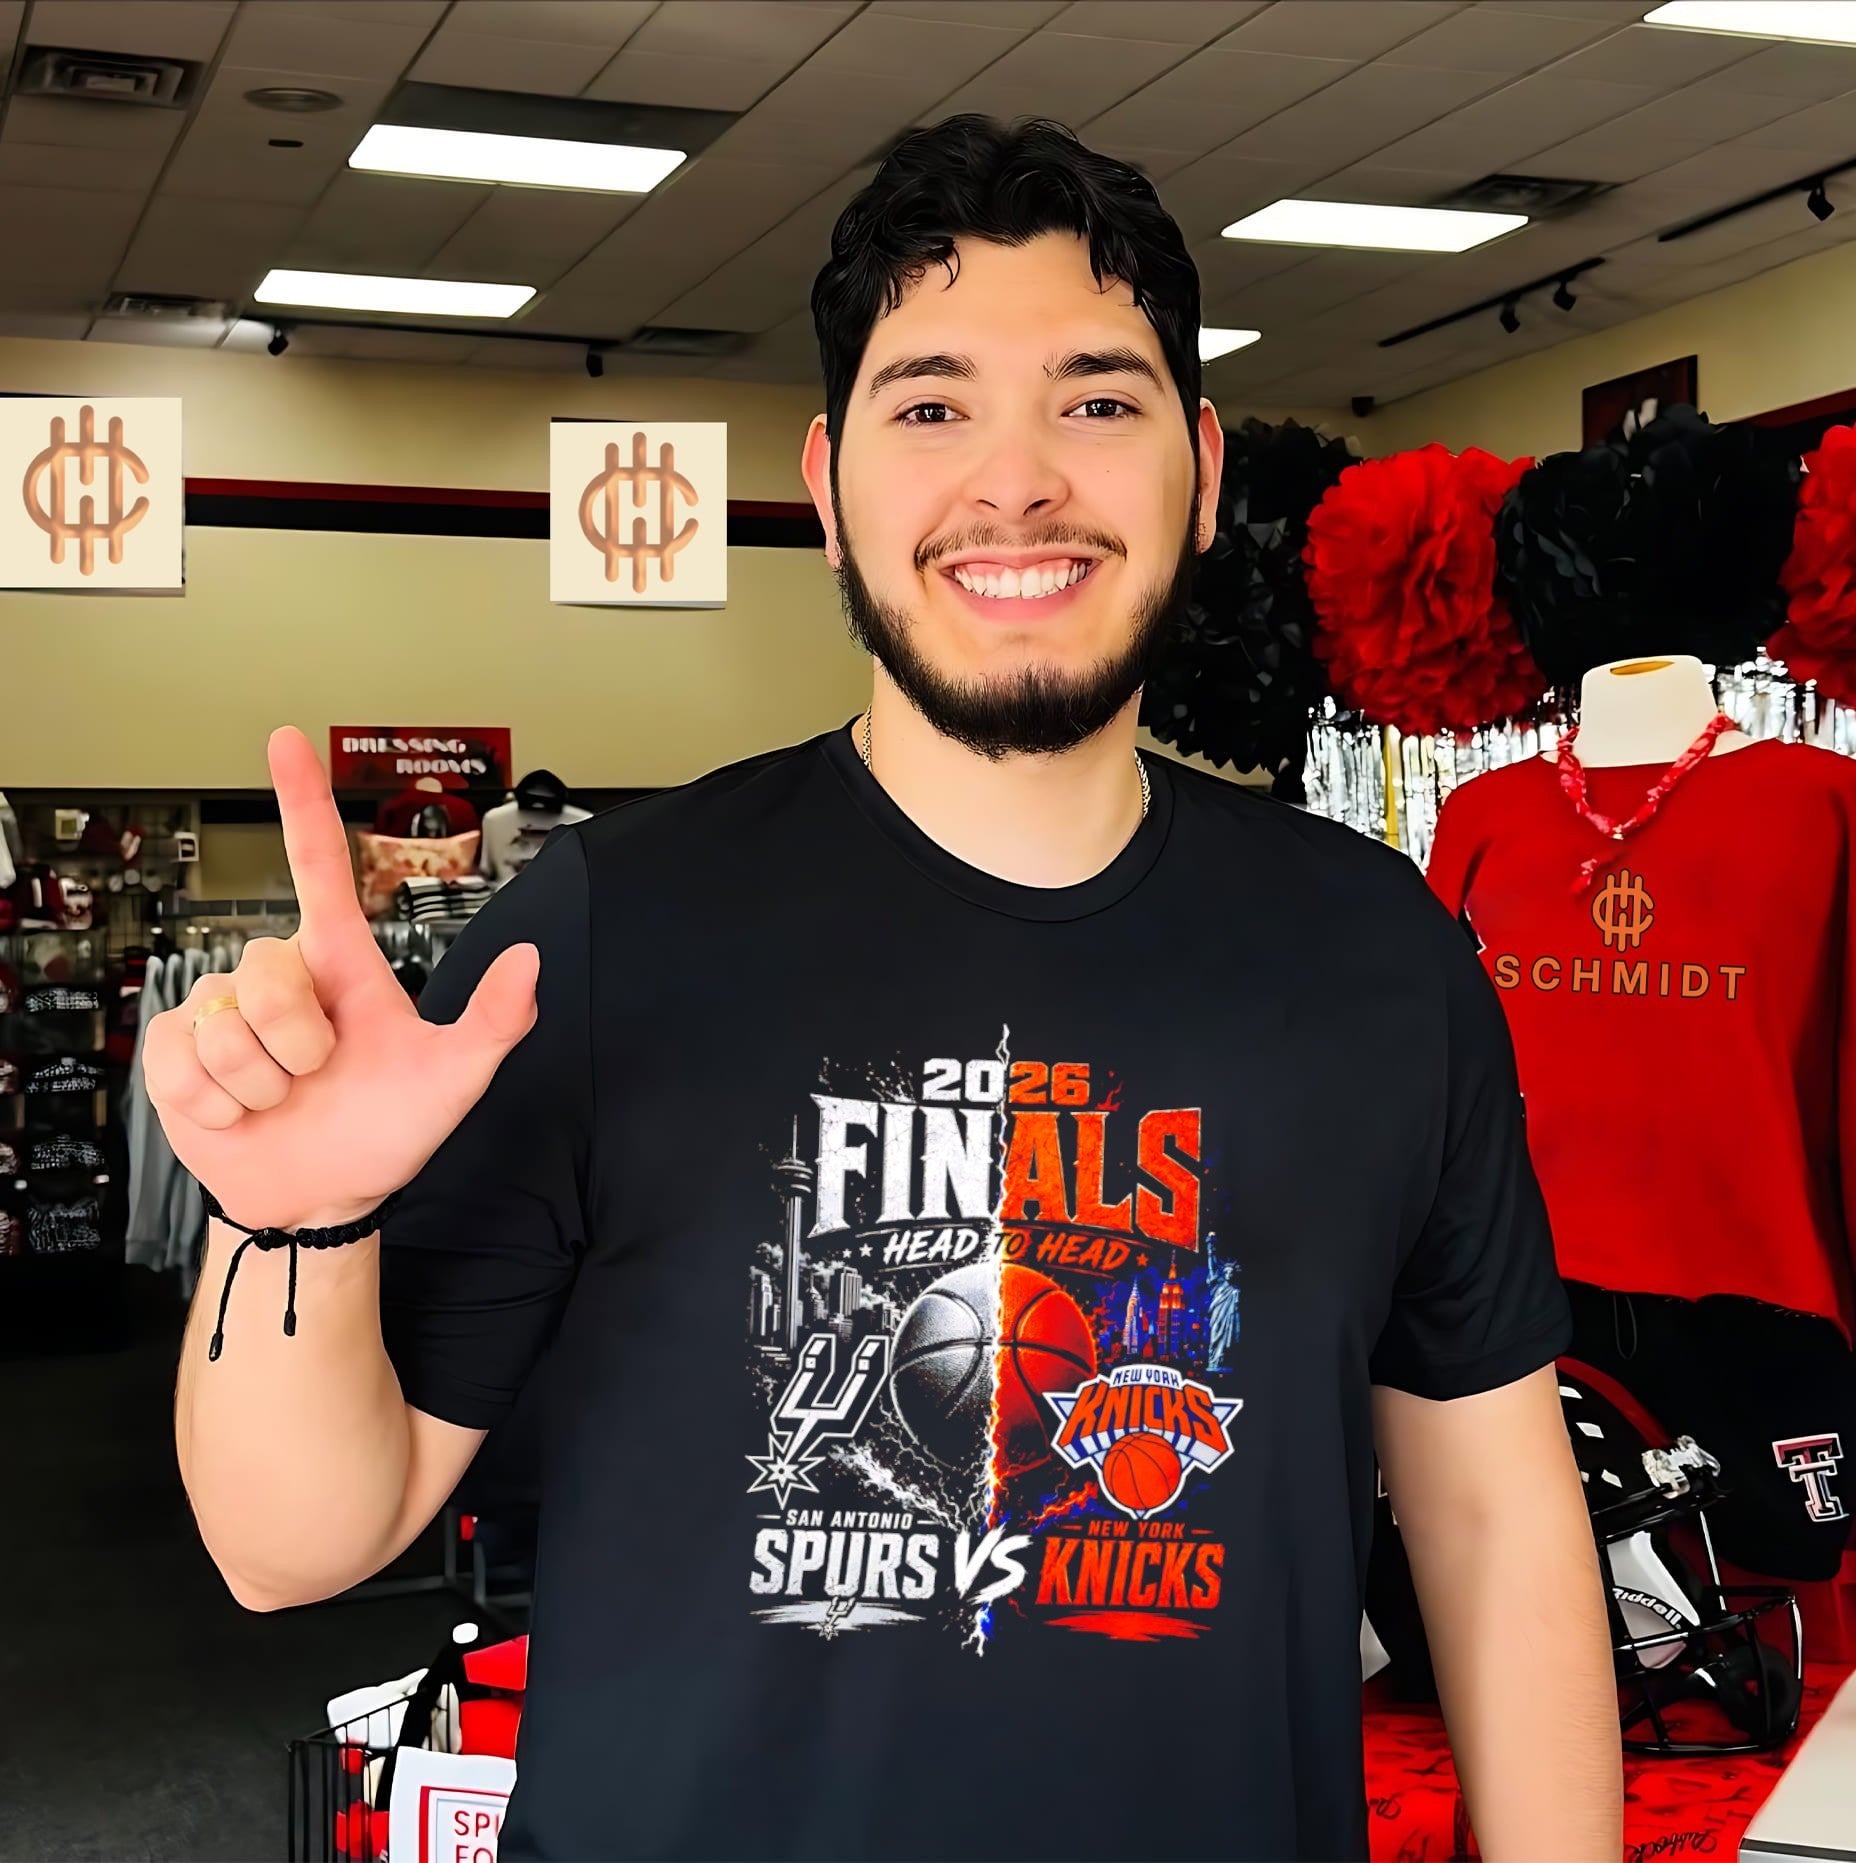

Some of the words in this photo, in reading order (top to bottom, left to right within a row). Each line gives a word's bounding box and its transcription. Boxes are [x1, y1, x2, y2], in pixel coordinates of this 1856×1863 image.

[342, 737, 467, 753] DRESSING
[396, 758, 487, 775] ROOMS
[1493, 953, 1747, 1000] SCHMIDT
[922, 1058, 1090, 1106] 2026
[807, 1093, 1201, 1253] FINALS
[882, 1228, 980, 1266] HEAD
[994, 1231, 1028, 1258] TO
[1036, 1232, 1131, 1272] HEAD
[1112, 1369, 1142, 1385] NEW
[1145, 1369, 1181, 1388] YORK
[1056, 1380, 1229, 1455] KNICKS
[786, 1509, 824, 1527] SAN
[830, 1511, 914, 1530] ANTONIO
[1087, 1520, 1130, 1538] NEW
[1138, 1521, 1186, 1540] YORK
[749, 1528, 940, 1600] SPURS
[954, 1521, 1034, 1603] VS
[1035, 1536, 1226, 1609] KNICKS
